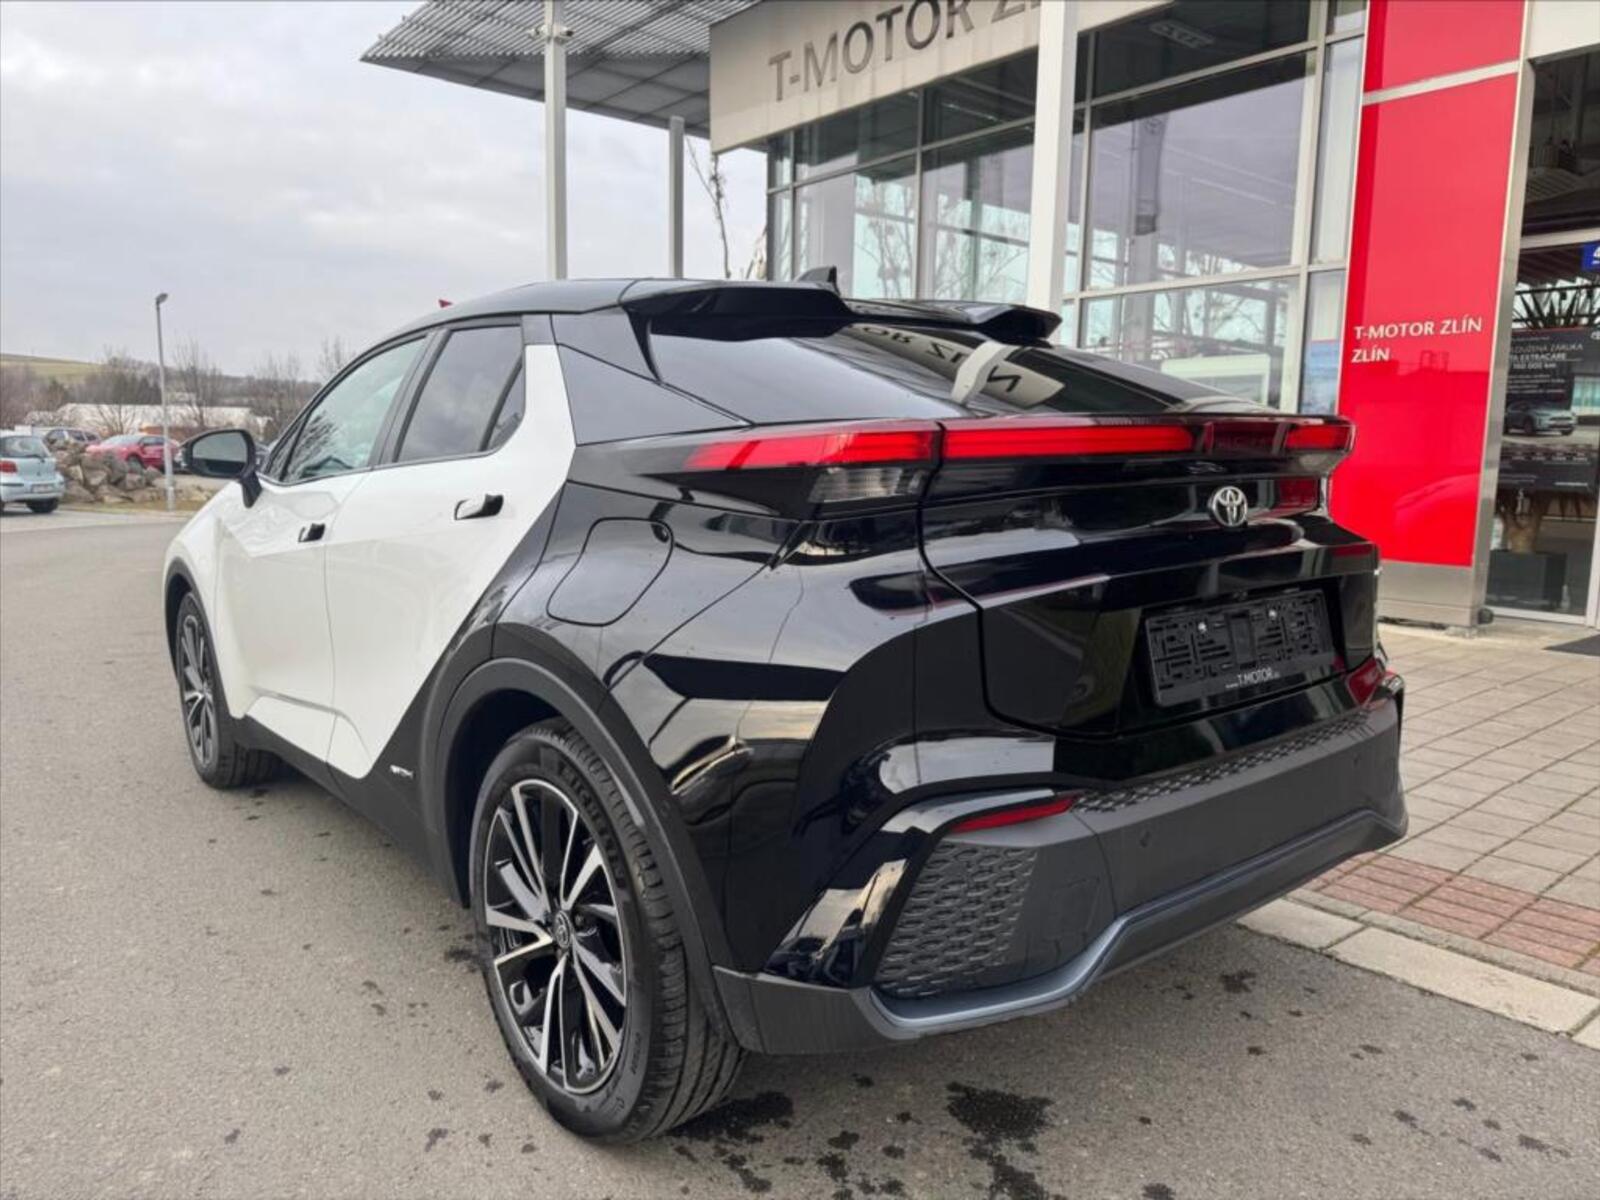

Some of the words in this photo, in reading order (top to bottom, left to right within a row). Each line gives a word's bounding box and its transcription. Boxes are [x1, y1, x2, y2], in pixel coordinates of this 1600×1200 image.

[769, 0, 974, 101] T-MOTOR
[1354, 321, 1434, 339] T-MOTOR
[1440, 314, 1482, 334] ZLÍN
[1351, 344, 1390, 363] ZLÍN
